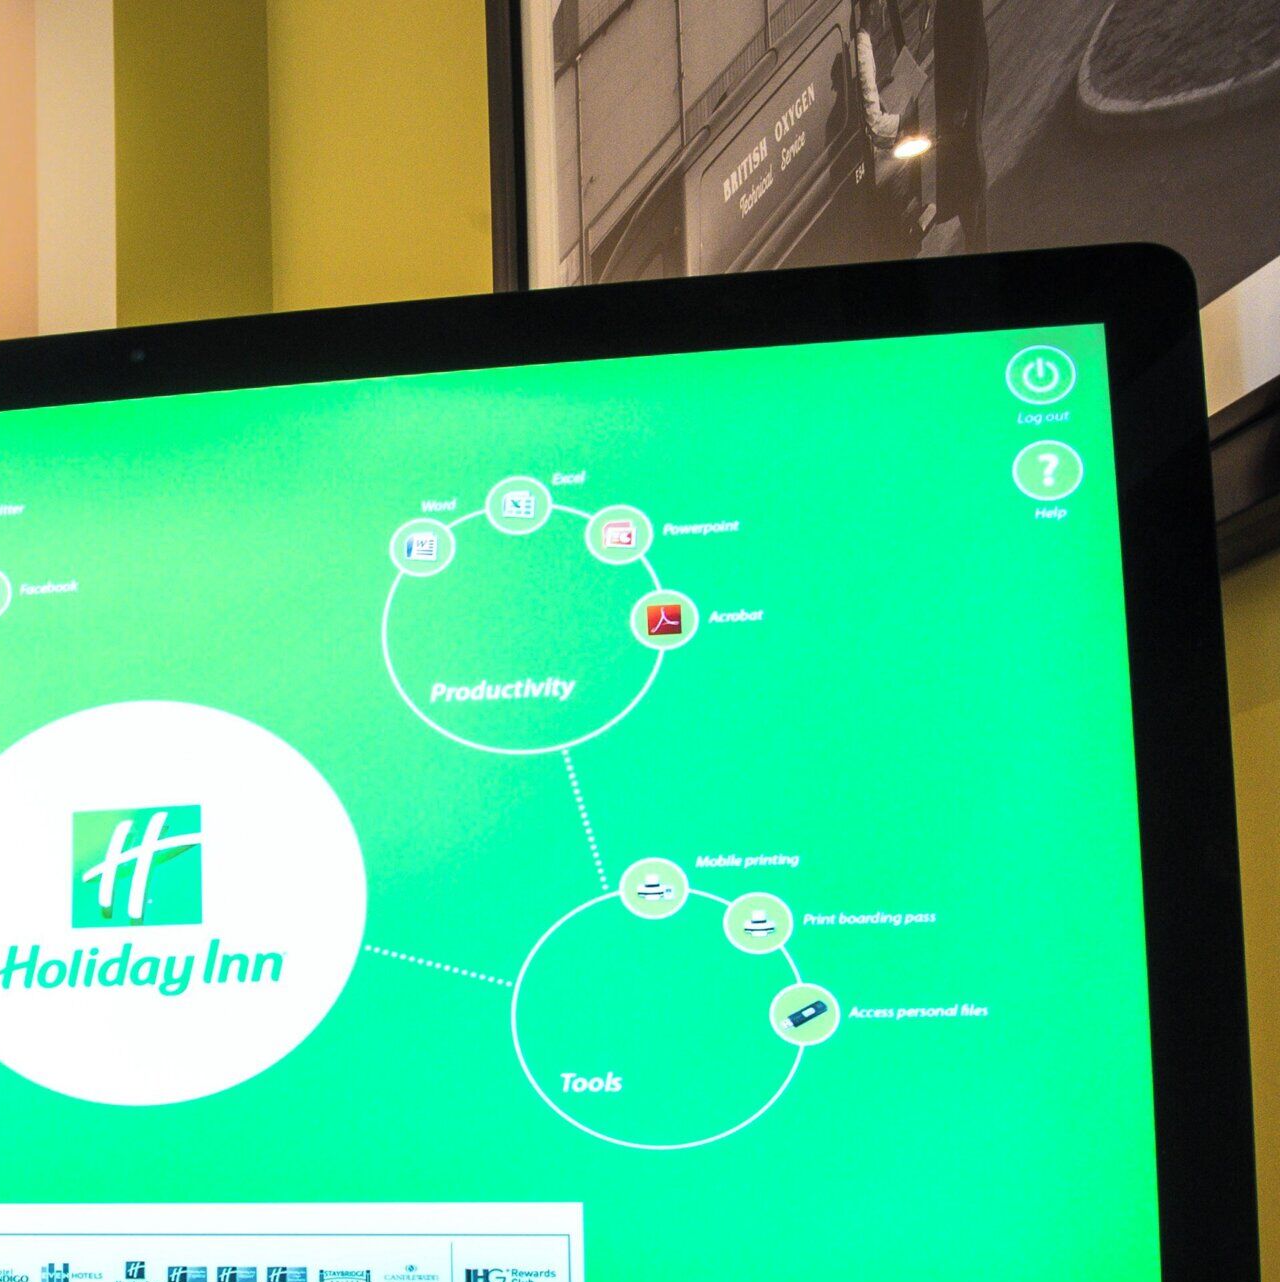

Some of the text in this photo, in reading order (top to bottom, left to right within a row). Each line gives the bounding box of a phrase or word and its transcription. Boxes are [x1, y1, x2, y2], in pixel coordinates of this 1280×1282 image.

[723, 83, 815, 203] BRITISH OXYGEN
[740, 131, 806, 219] Technical Service
[1017, 411, 1070, 425] Log out
[552, 471, 586, 486] Excel
[421, 497, 456, 513] Word
[1035, 506, 1067, 520] Help
[663, 520, 740, 536] Powerpoint
[19, 580, 79, 596] Facebook
[708, 609, 763, 624] Acrobat
[430, 676, 576, 702] Productivity
[696, 854, 800, 869] Mobile printing
[803, 912, 937, 926] Print boarding pass
[0, 938, 283, 997] Holiday Inn
[848, 1004, 988, 1020] Access personal files
[560, 1071, 623, 1093] Tools
[71, 1272, 103, 1280] HOTELS
[511, 1269, 557, 1278] Rewards
